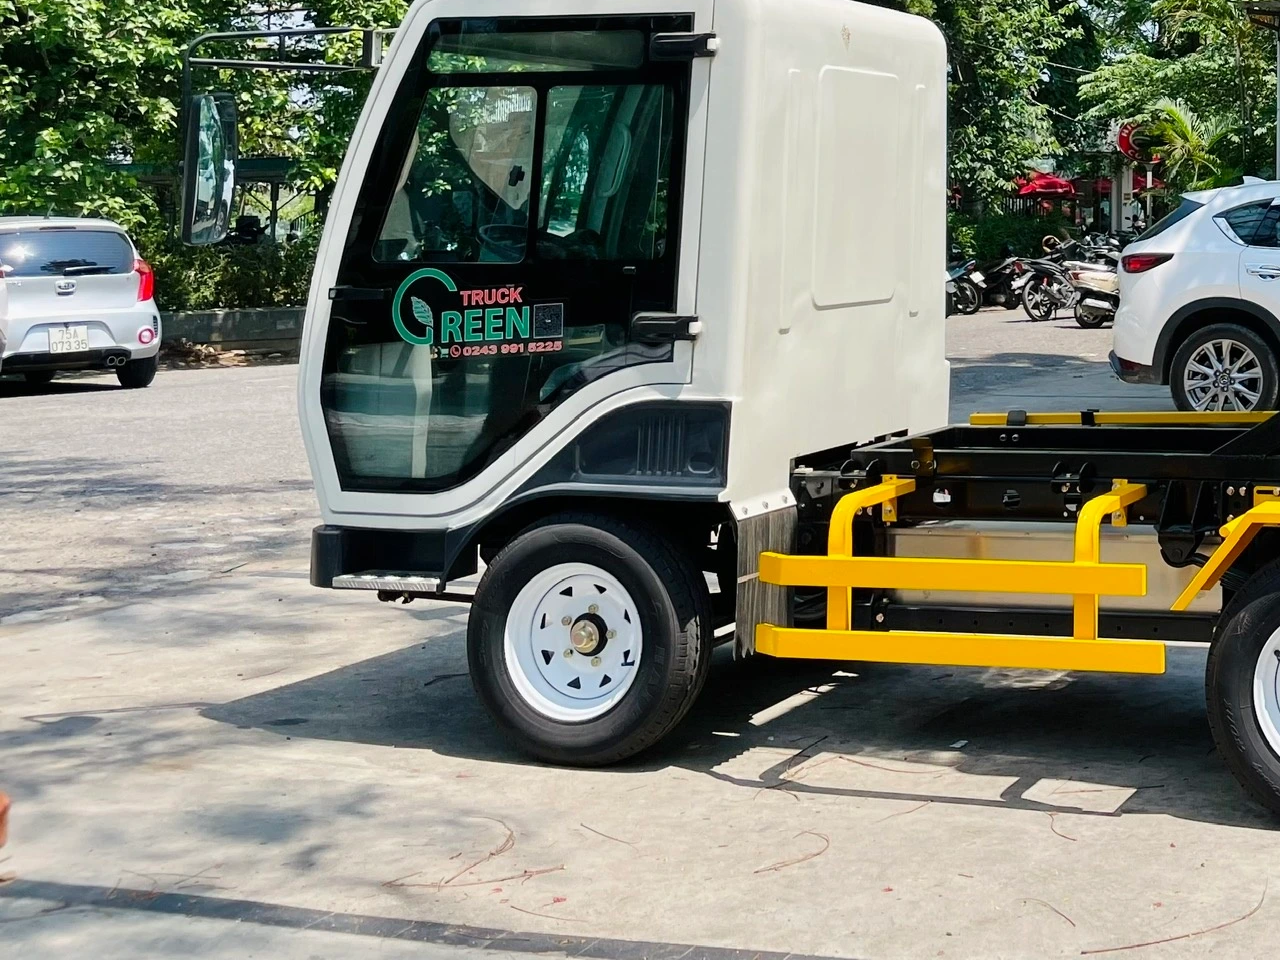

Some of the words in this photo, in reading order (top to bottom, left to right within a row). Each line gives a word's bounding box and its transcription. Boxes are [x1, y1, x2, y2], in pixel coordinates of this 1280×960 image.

[460, 286, 523, 306] TRUCK
[392, 268, 530, 345] GREEN
[58, 329, 79, 340] 75A
[462, 344, 498, 356] 0243
[500, 342, 524, 354] 991
[527, 341, 563, 353] 5225
